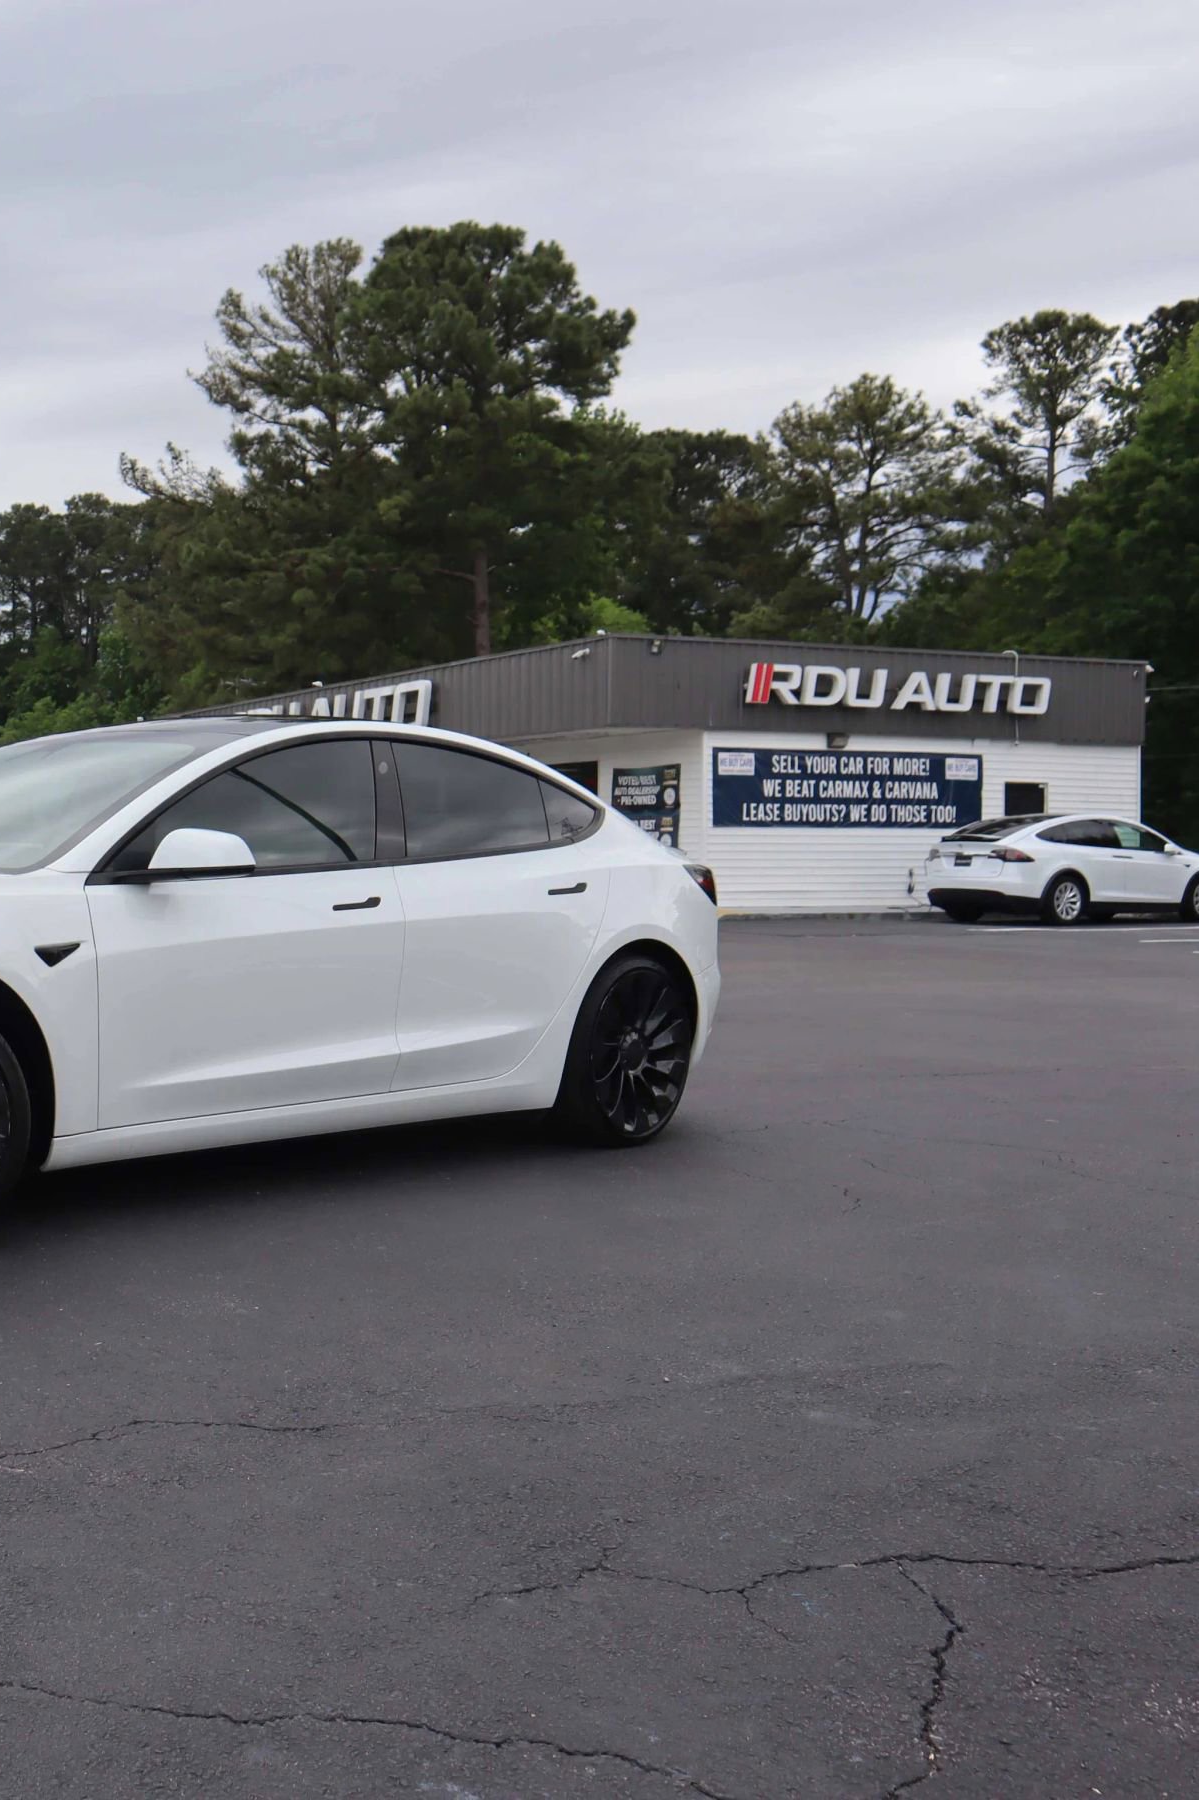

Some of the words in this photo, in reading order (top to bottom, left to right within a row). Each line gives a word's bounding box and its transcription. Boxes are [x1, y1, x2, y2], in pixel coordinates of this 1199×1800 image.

[763, 662, 889, 708] RDU
[890, 671, 1051, 715] AUTO
[771, 754, 802, 774] SELL
[805, 755, 837, 775] YOUR
[840, 756, 864, 775] CAR
[866, 756, 890, 776] FOR
[892, 757, 930, 776] MORE!
[762, 778, 783, 798] WE
[785, 779, 816, 798] BEAT
[818, 780, 870, 799] CARMAX
[872, 780, 882, 799] &
[884, 781, 939, 799] CARVANA
[742, 802, 781, 822] LEASE
[783, 803, 847, 823] BUYOUTS?
[849, 804, 868, 823] WE
[870, 804, 887, 823] DO
[889, 804, 927, 823] THOSE
[930, 805, 957, 824] TOO!
